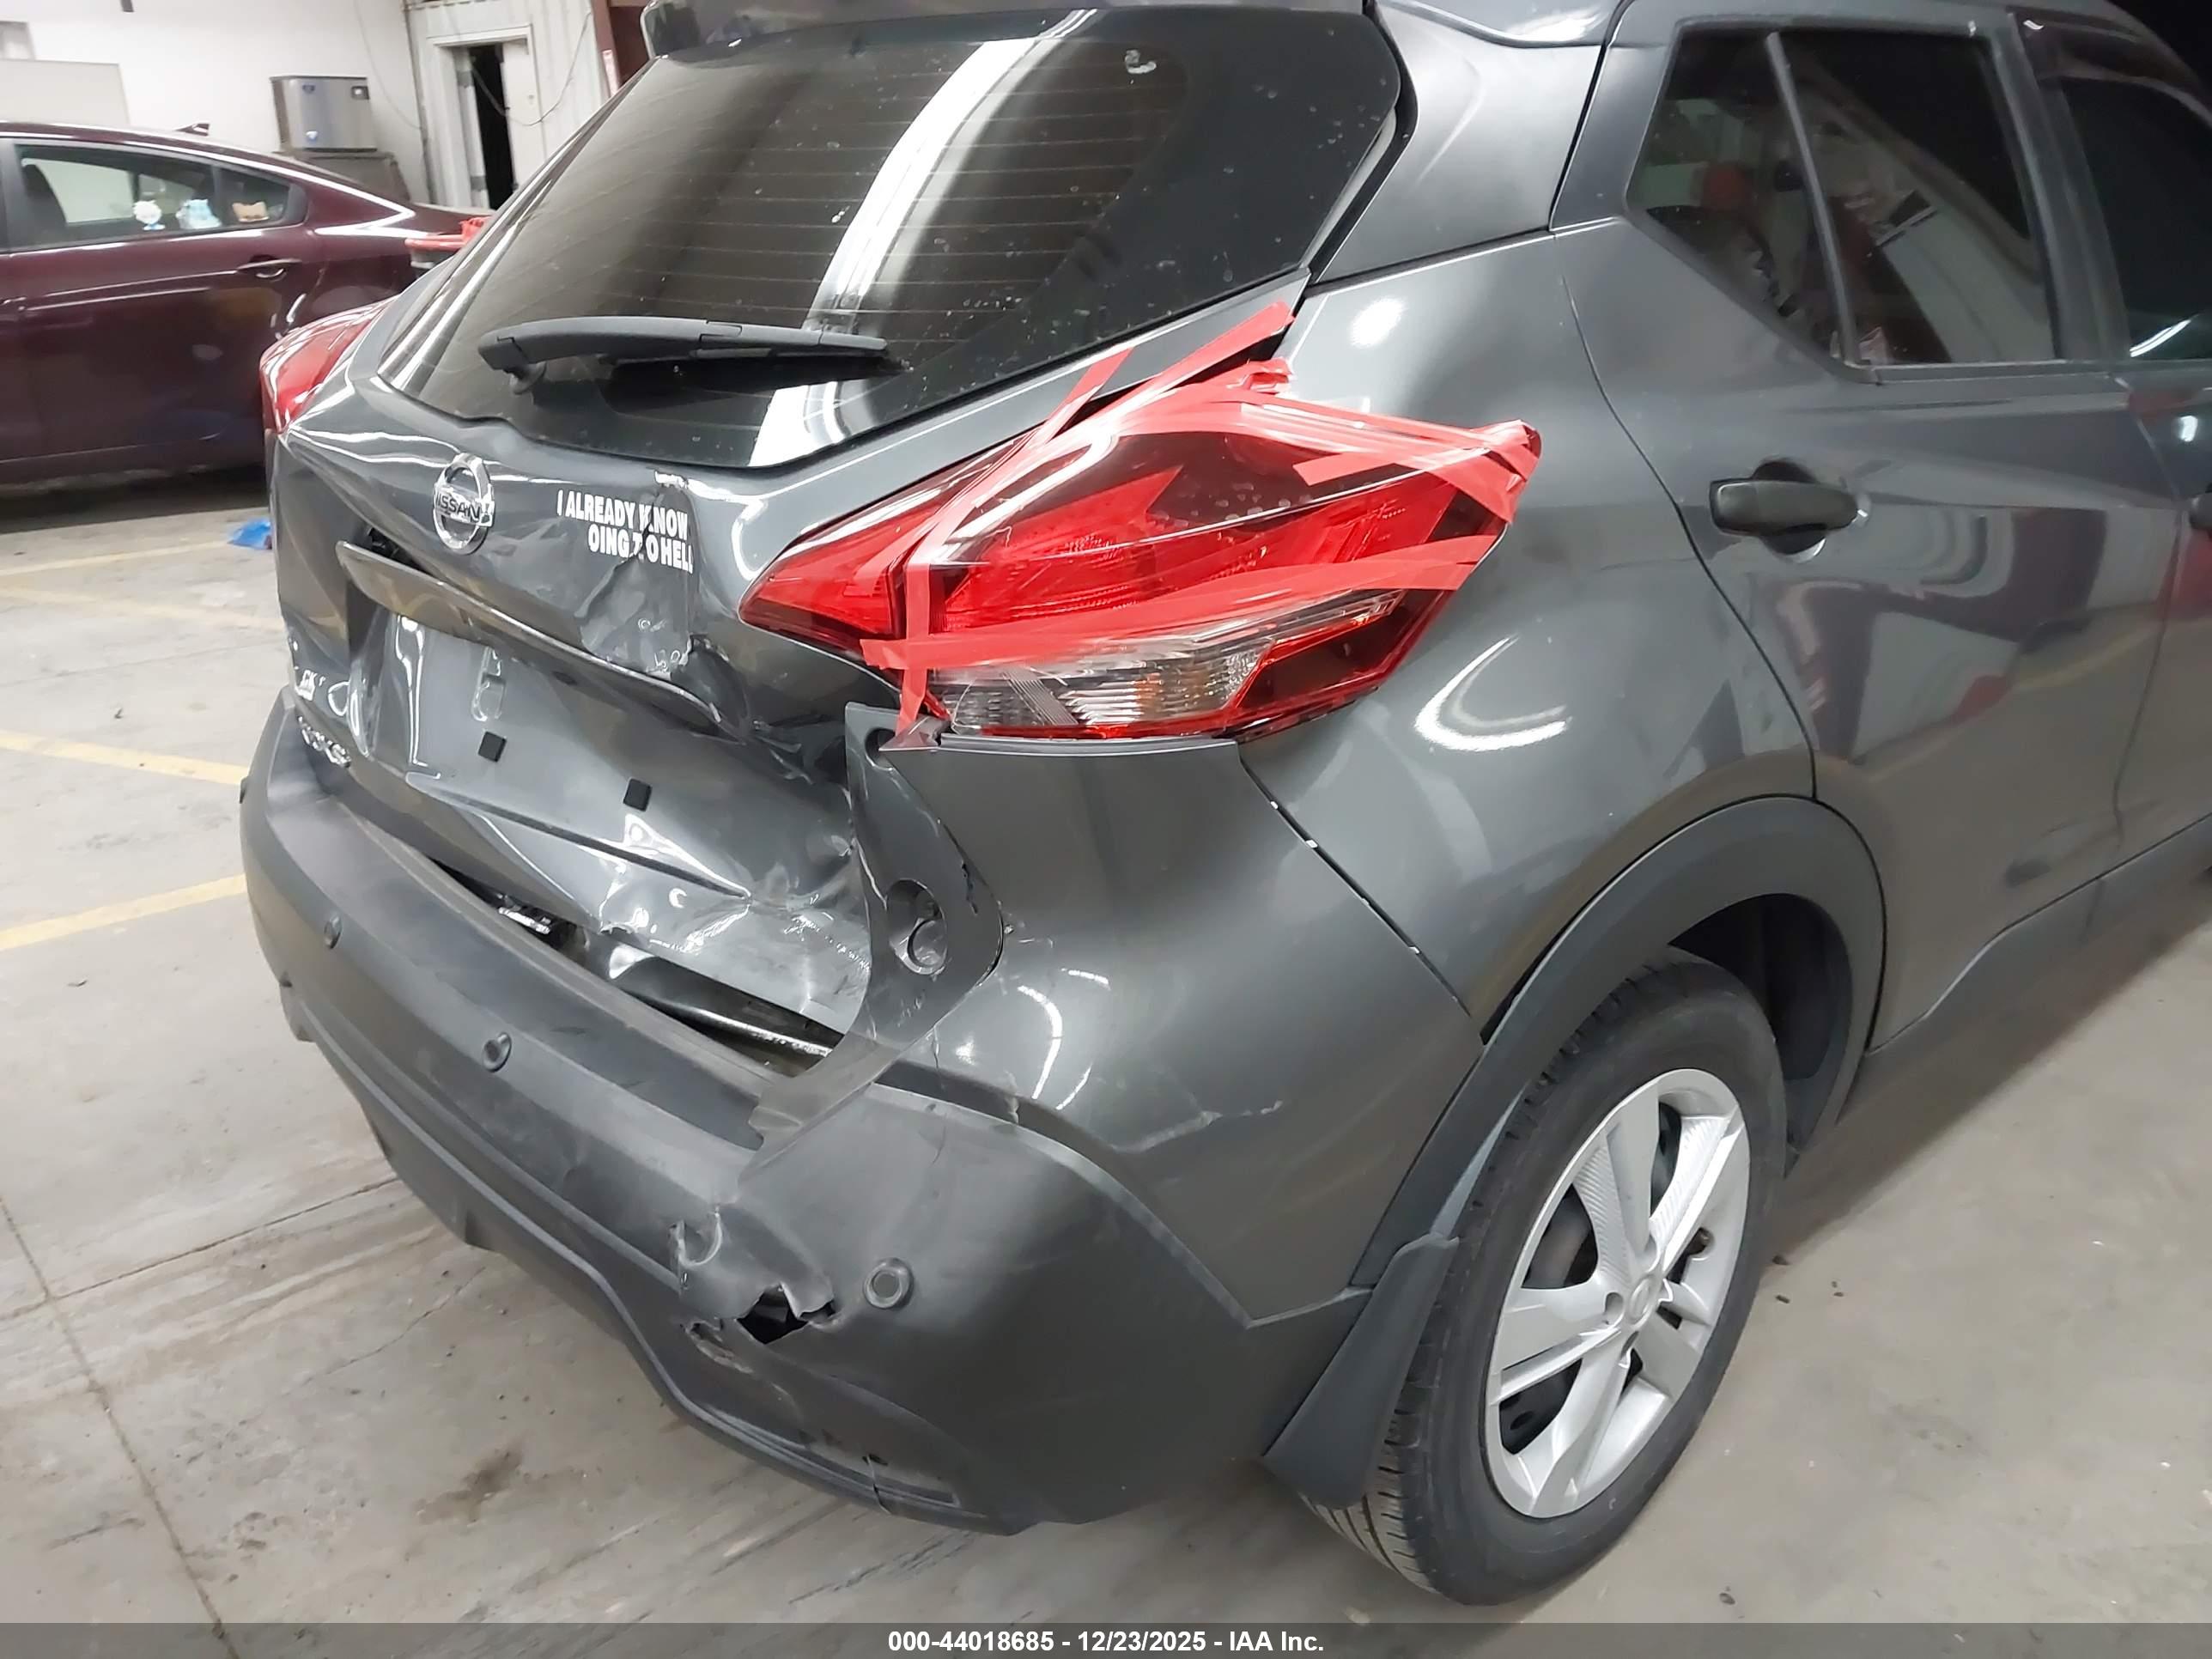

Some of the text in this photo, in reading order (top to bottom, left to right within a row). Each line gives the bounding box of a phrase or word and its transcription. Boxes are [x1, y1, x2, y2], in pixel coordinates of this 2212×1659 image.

[556, 489, 688, 540] I ALREADY KNOW
[660, 537, 693, 574] HELL
